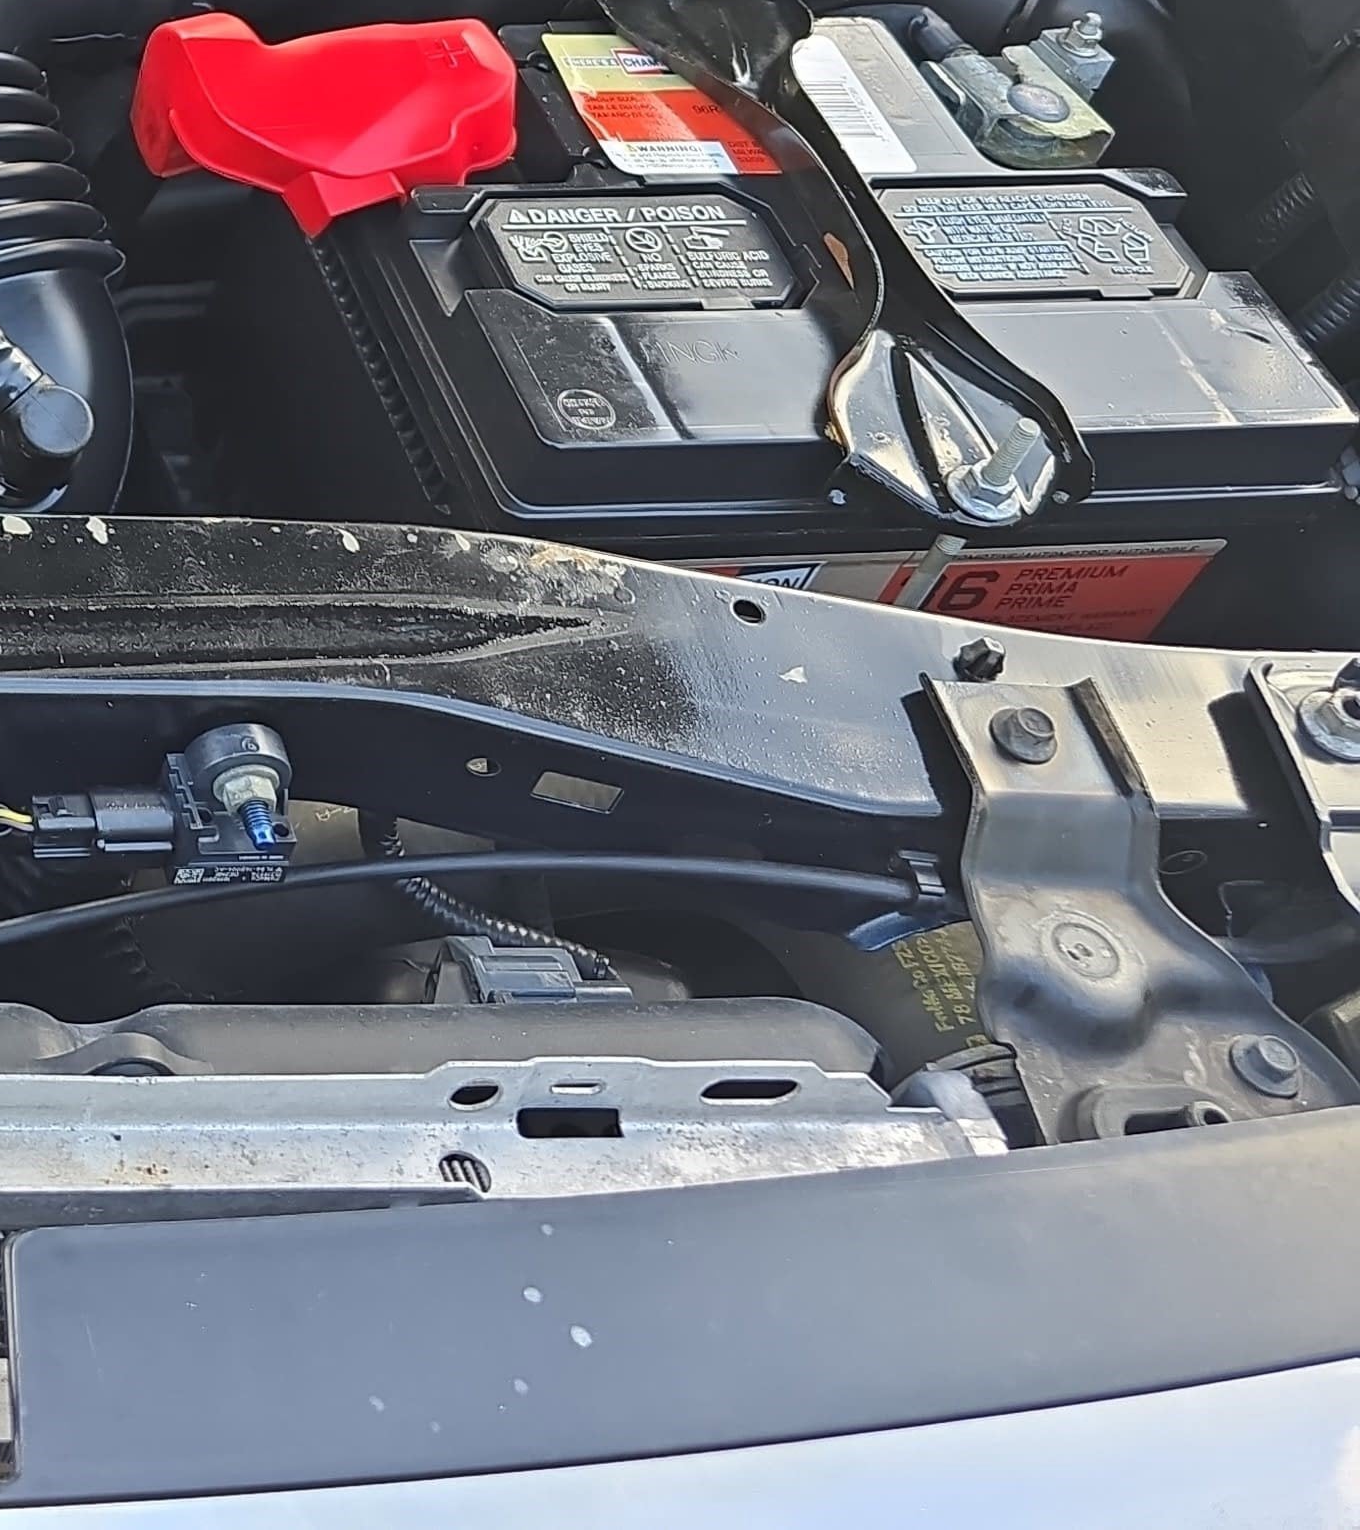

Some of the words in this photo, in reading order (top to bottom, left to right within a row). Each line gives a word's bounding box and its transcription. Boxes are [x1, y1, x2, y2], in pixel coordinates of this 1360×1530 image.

[527, 208, 622, 223] DANGER
[627, 208, 634, 222] /
[640, 205, 726, 222] POISON
[568, 233, 608, 244] SHIELD
[575, 243, 603, 253] EYES
[551, 253, 613, 263] EXPLOSIVE
[641, 253, 662, 262] NO
[687, 252, 741, 262] SULFURIC
[743, 251, 770, 261] ACID
[558, 263, 596, 273] GASES
[693, 261, 715, 270] CAN
[716, 261, 748, 270] CAUSE
[699, 270, 751, 279] BLINDNESS
[1014, 565, 1130, 582] PREMIUM
[1006, 582, 1079, 596] PRIMA
[995, 595, 1072, 609] PRIME
